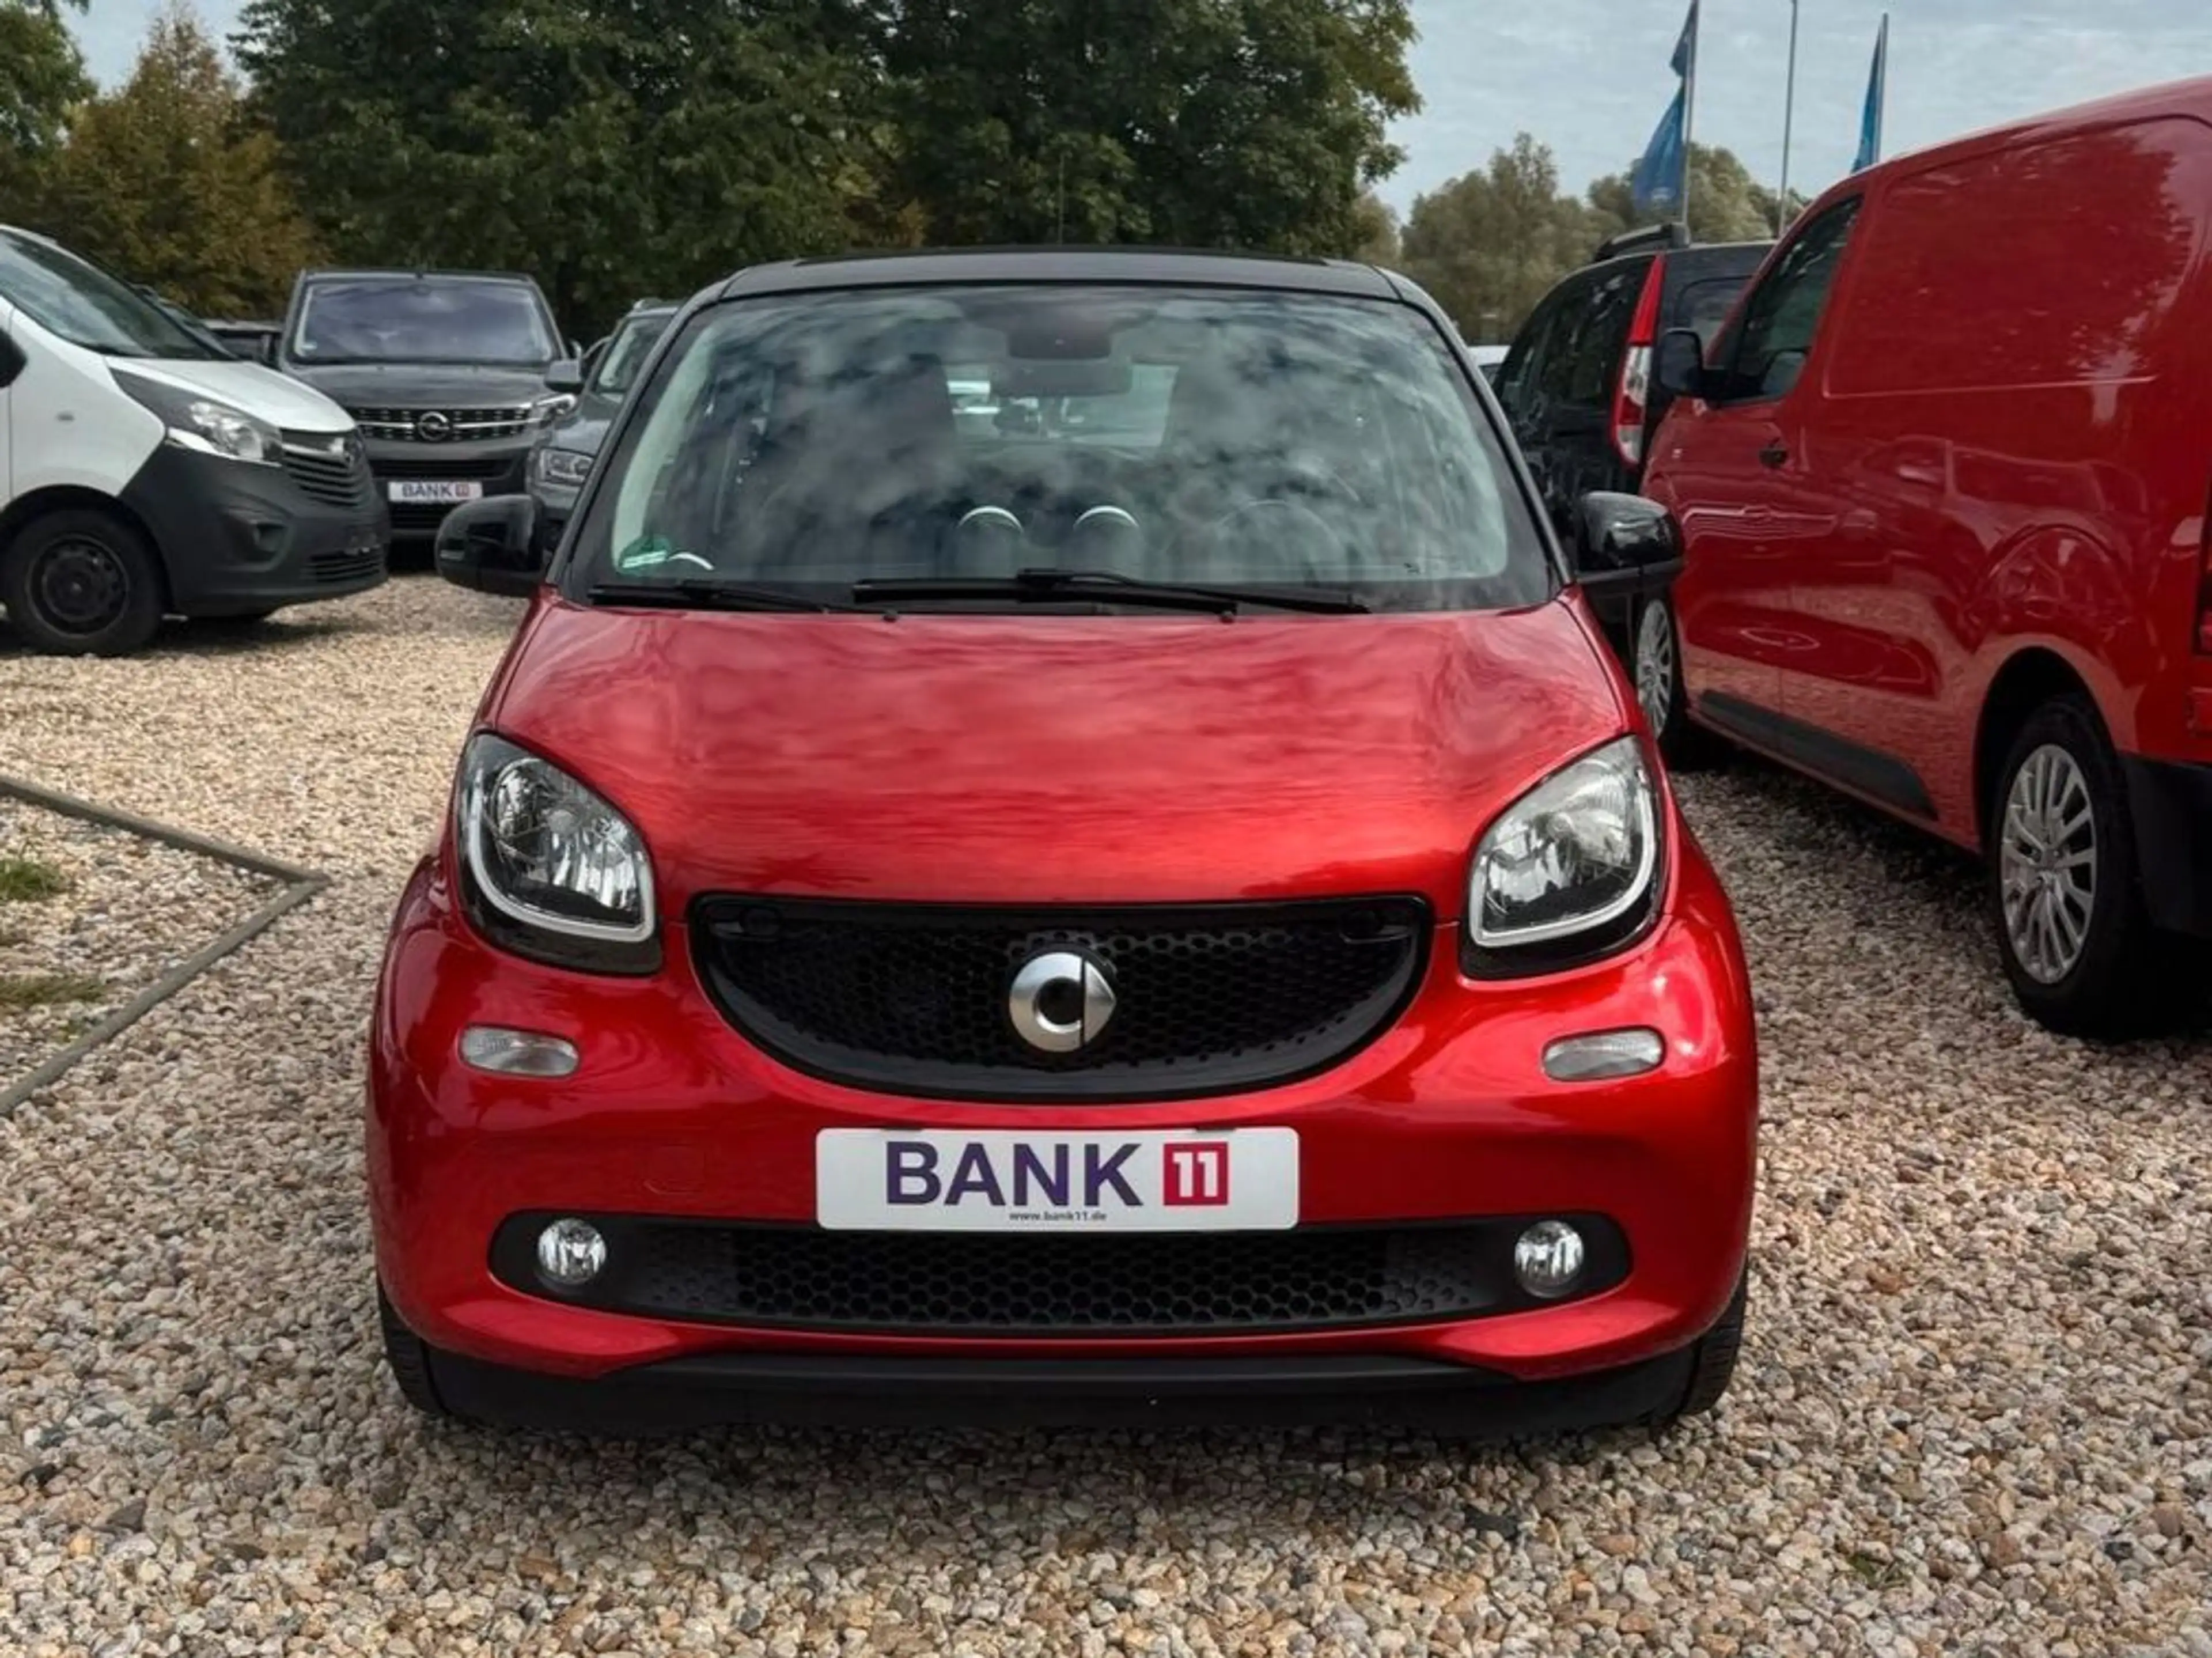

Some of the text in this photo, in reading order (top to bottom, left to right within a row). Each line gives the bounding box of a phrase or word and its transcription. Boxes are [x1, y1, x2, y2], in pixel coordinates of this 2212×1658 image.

[886, 1141, 1219, 1206] BANK 11
[1009, 1210, 1107, 1221] www.bank11.de
